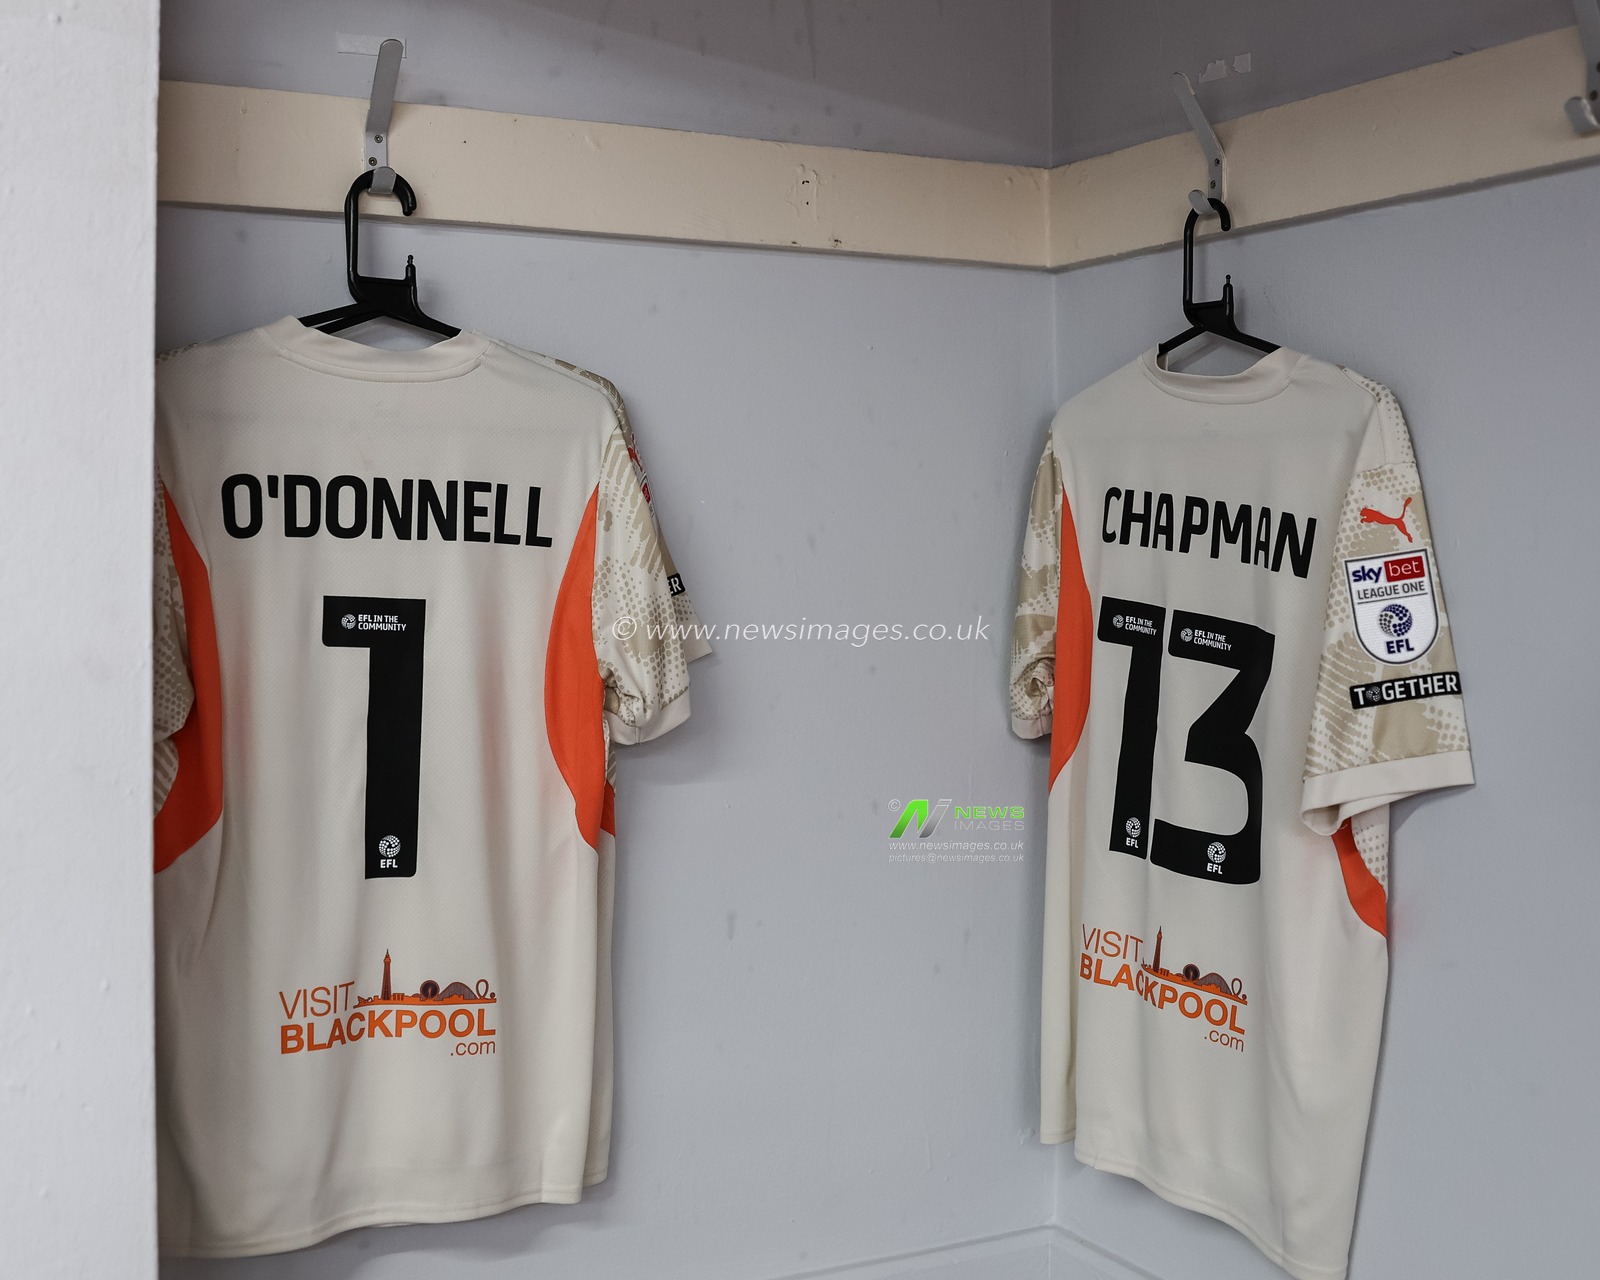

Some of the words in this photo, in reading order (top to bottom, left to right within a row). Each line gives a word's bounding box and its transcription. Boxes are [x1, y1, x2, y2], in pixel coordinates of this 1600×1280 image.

[221, 473, 552, 547] O'DONNELL
[1102, 487, 1317, 578] CHAPMAN
[1351, 565, 1382, 583] sky
[1388, 560, 1421, 577] bet
[1357, 584, 1399, 600] LEAGUE
[1402, 581, 1425, 594] ONE
[358, 614, 372, 622] EFL
[373, 614, 383, 623] IN
[384, 615, 399, 623] THE
[358, 622, 406, 632] COMMUNITY
[1125, 615, 1137, 624] EFL
[1137, 617, 1144, 625] IN
[1144, 618, 1154, 628] THE
[1125, 623, 1157, 636] COMMUNITY
[1194, 629, 1206, 638] EFL
[1206, 631, 1215, 639] IN
[1214, 633, 1227, 642] THE
[1193, 637, 1232, 652] COMMUNITY
[1386, 638, 1415, 655] EFL
[322, 595, 427, 879] 1
[1097, 596, 1275, 885] 13
[1125, 837, 1139, 849] EFL
[380, 858, 398, 869] EFL
[1206, 862, 1223, 875] EFL
[1082, 923, 1143, 962] VISIT
[278, 981, 355, 1020] VISIT
[1079, 952, 1245, 1035] BLACKPOOL
[280, 1008, 496, 1055] BLACKPOOL
[1204, 1029, 1244, 1052] .com
[450, 1040, 496, 1057] .com
